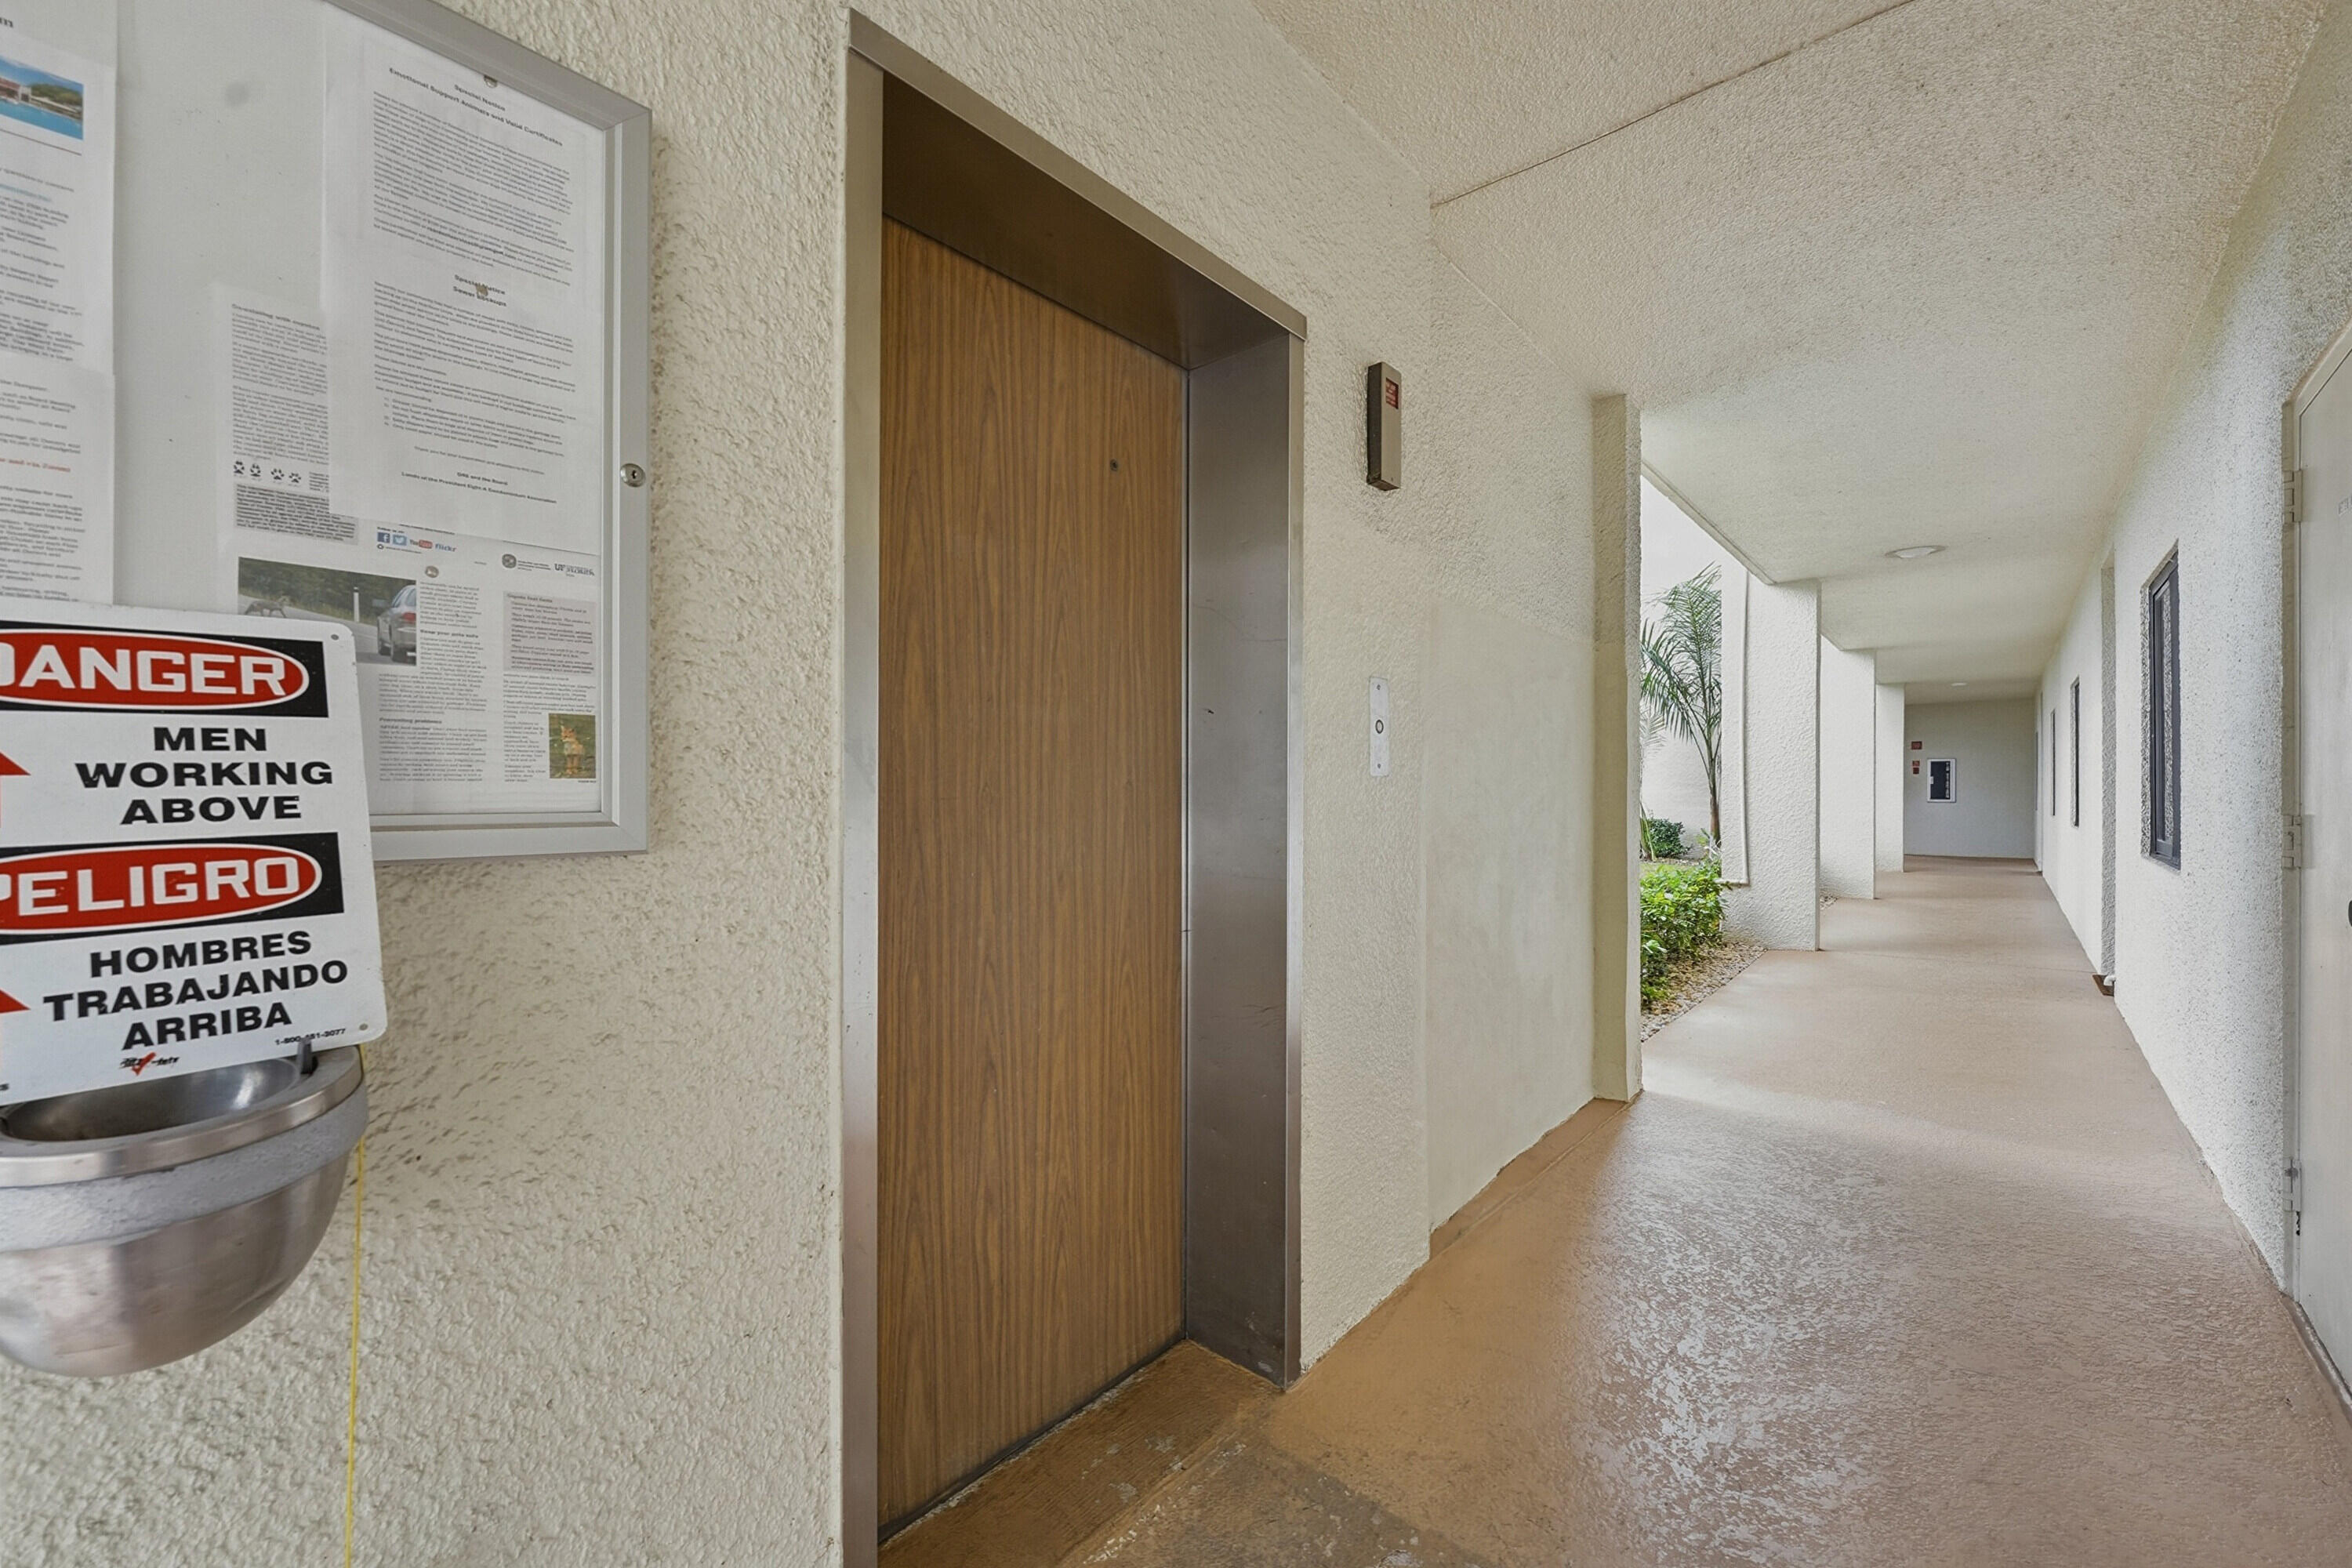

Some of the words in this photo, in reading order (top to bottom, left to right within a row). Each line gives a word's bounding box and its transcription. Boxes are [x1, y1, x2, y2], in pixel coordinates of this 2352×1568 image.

[0, 642, 285, 696] ANGER
[154, 727, 267, 751] MEN
[75, 761, 332, 788] WORKING
[120, 795, 302, 825] ABOVE
[0, 856, 299, 916] ELIGRO
[89, 931, 312, 978] HOMBRES
[43, 960, 347, 1022] TRABAJANDO
[122, 1002, 292, 1051] ARRIBA
